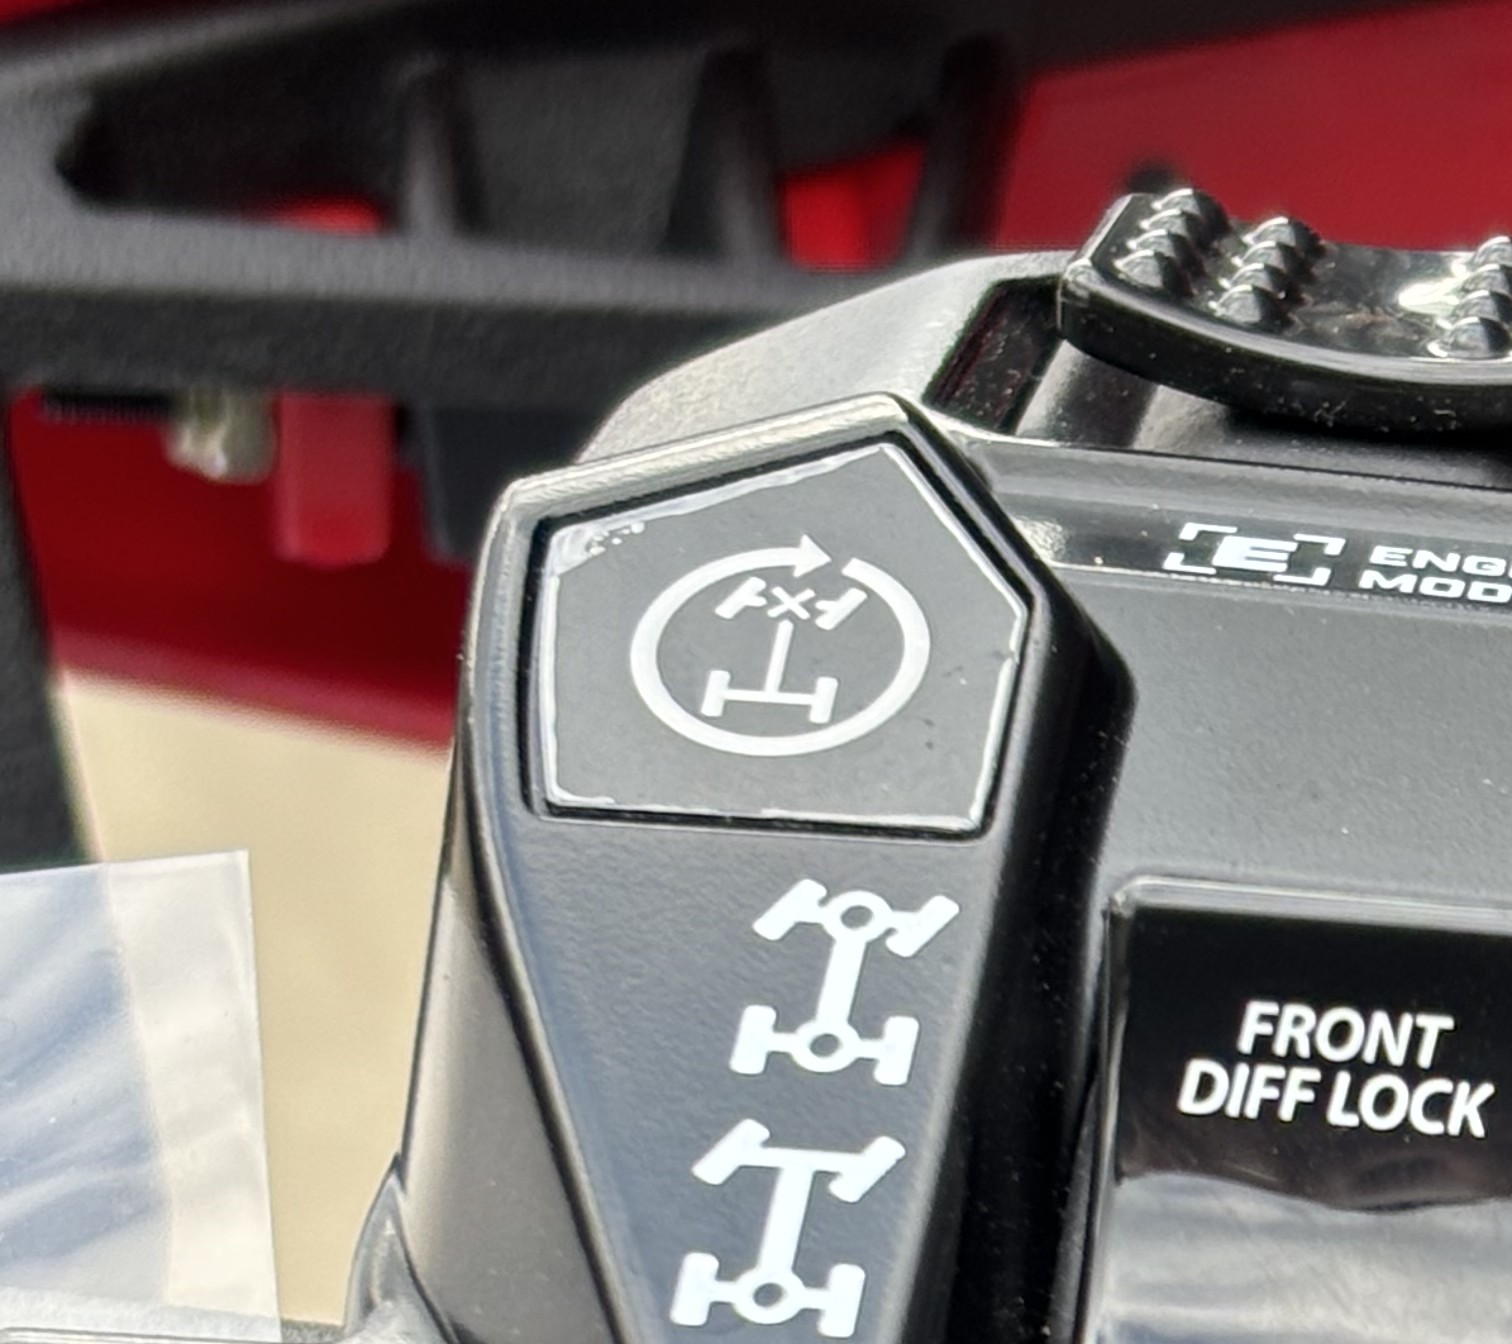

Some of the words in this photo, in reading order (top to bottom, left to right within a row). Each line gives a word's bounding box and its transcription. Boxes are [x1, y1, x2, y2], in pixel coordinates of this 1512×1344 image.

[1237, 1000, 1455, 1069] FRONT
[1177, 1058, 1322, 1122] DIFF
[1326, 1071, 1495, 1138] LOCK
